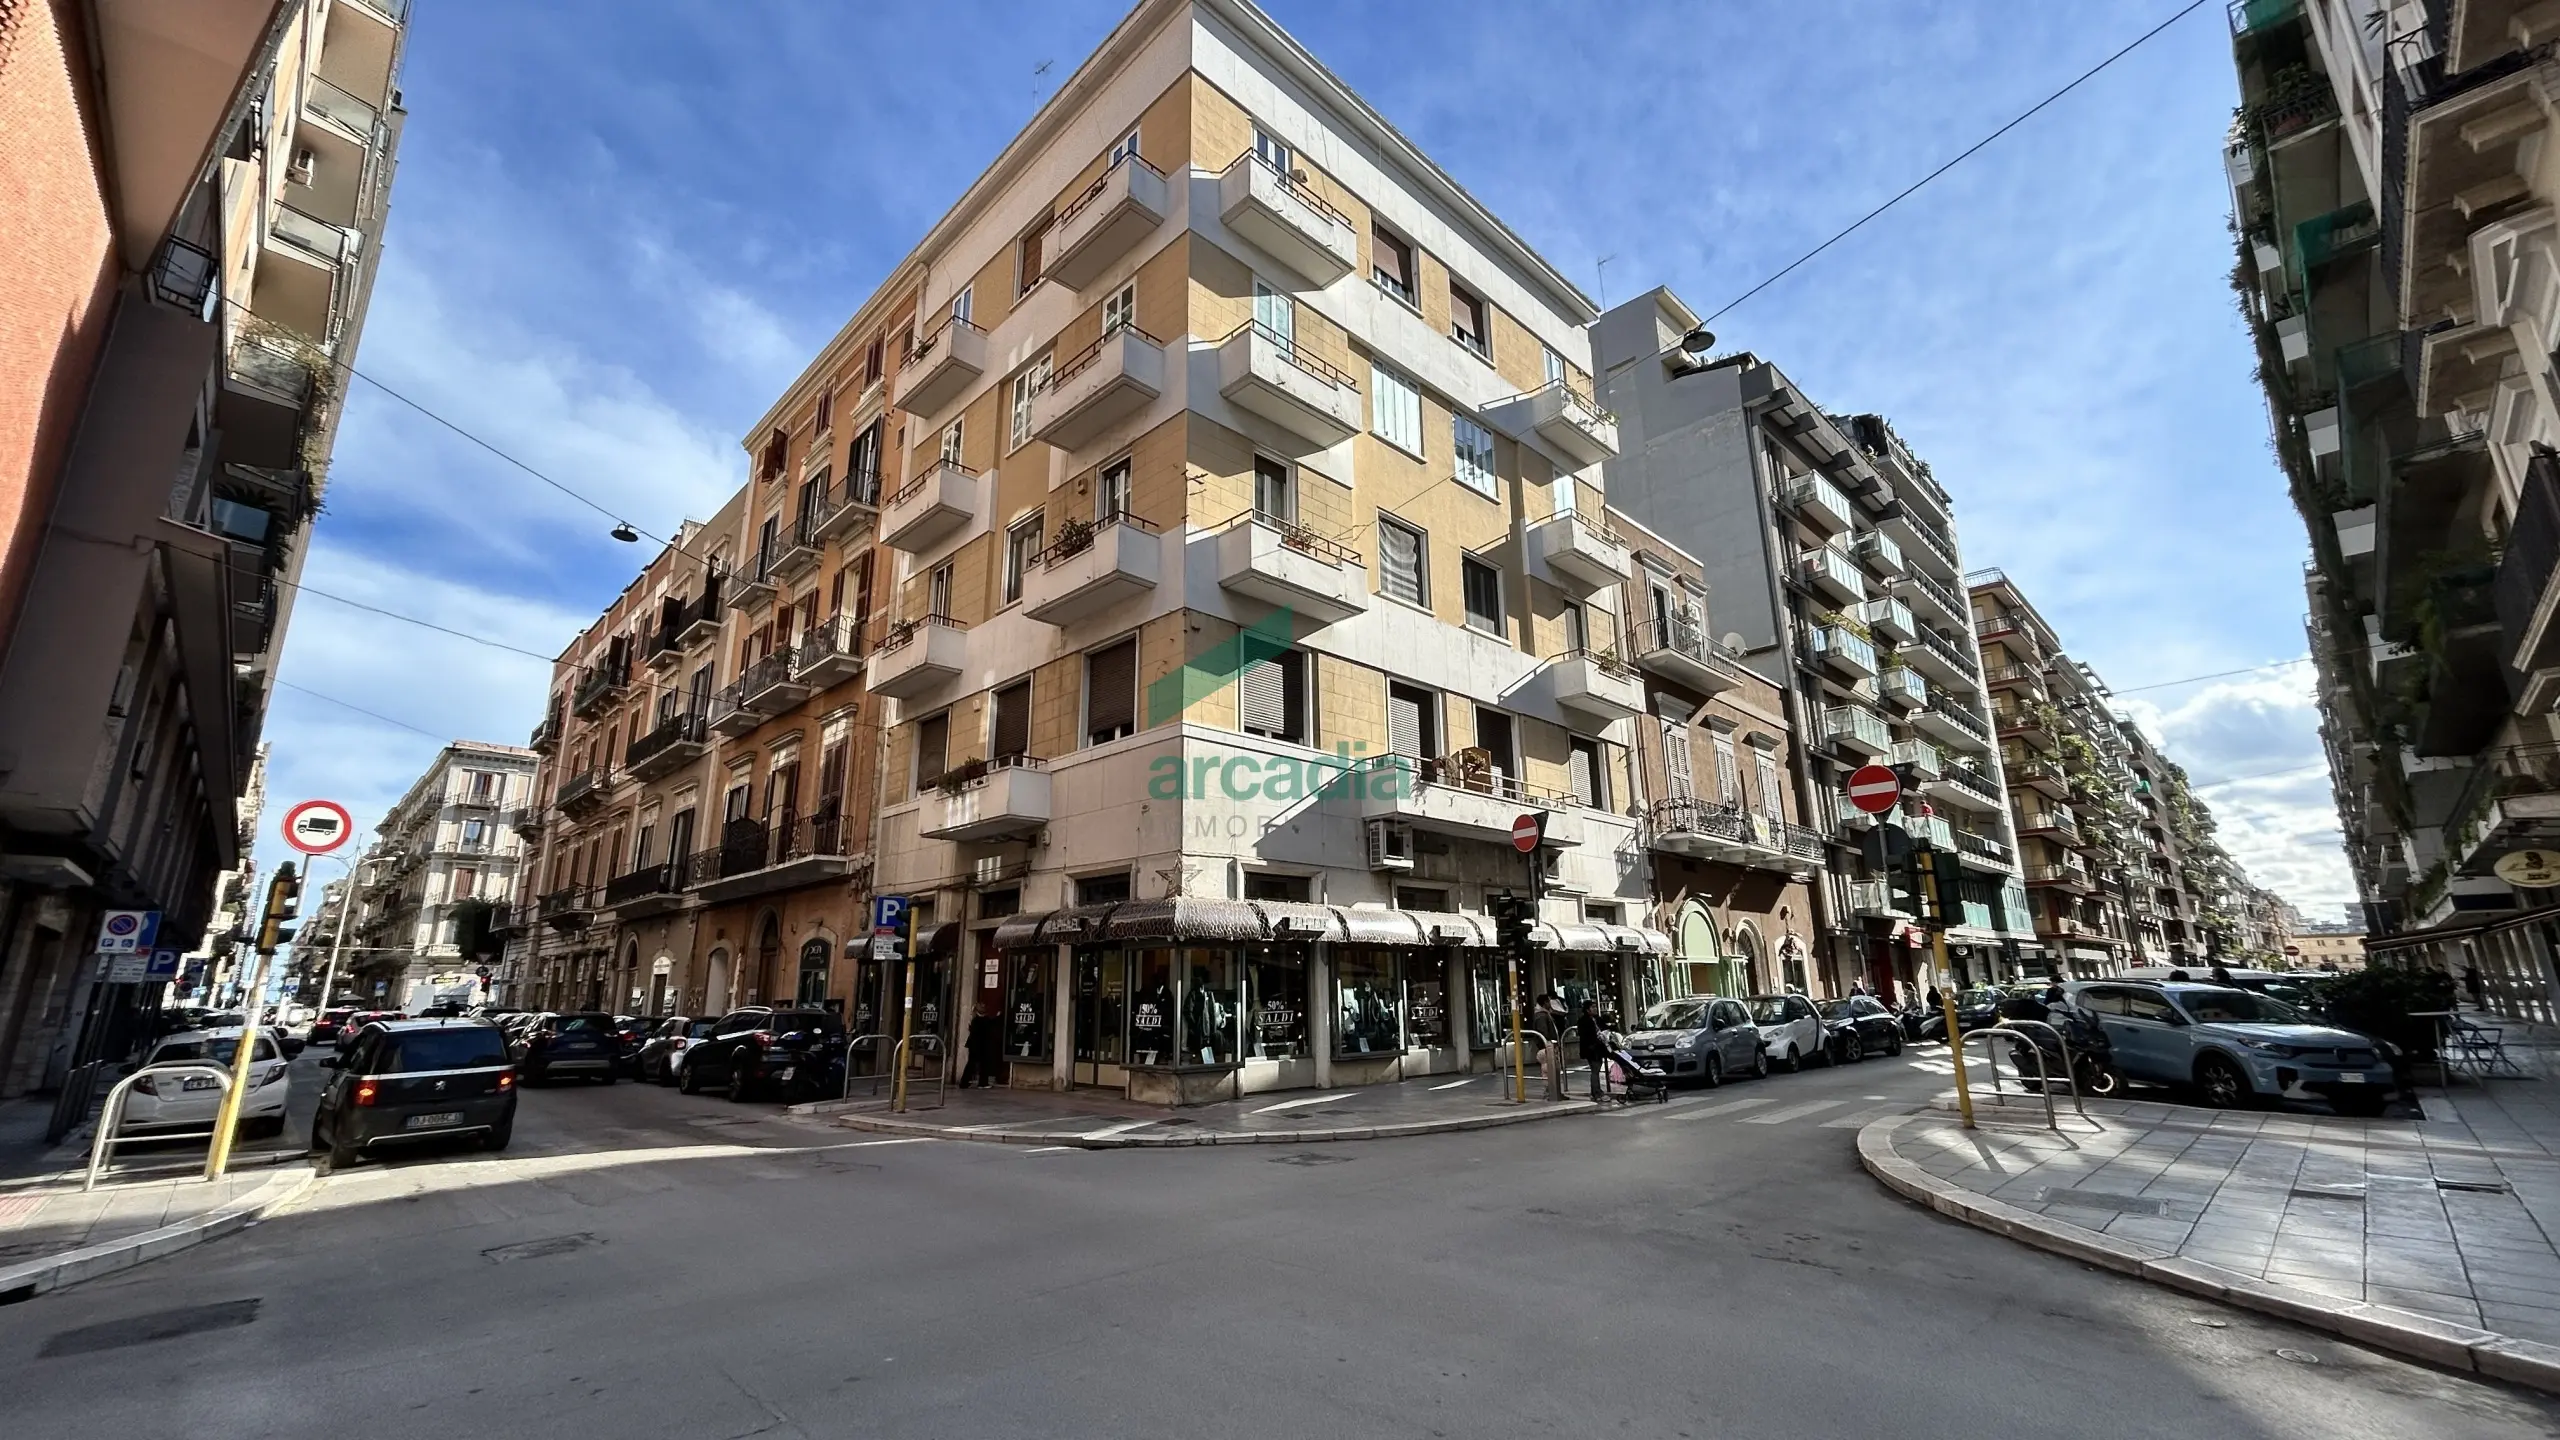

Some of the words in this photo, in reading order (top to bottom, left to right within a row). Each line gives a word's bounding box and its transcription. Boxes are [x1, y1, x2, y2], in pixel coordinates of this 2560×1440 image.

[881, 899, 900, 925] P
[152, 950, 176, 971] P
[1268, 1000, 1285, 1011] 50%
[1135, 1016, 1161, 1026] SALDI
[1258, 1012, 1294, 1023] SALDI
